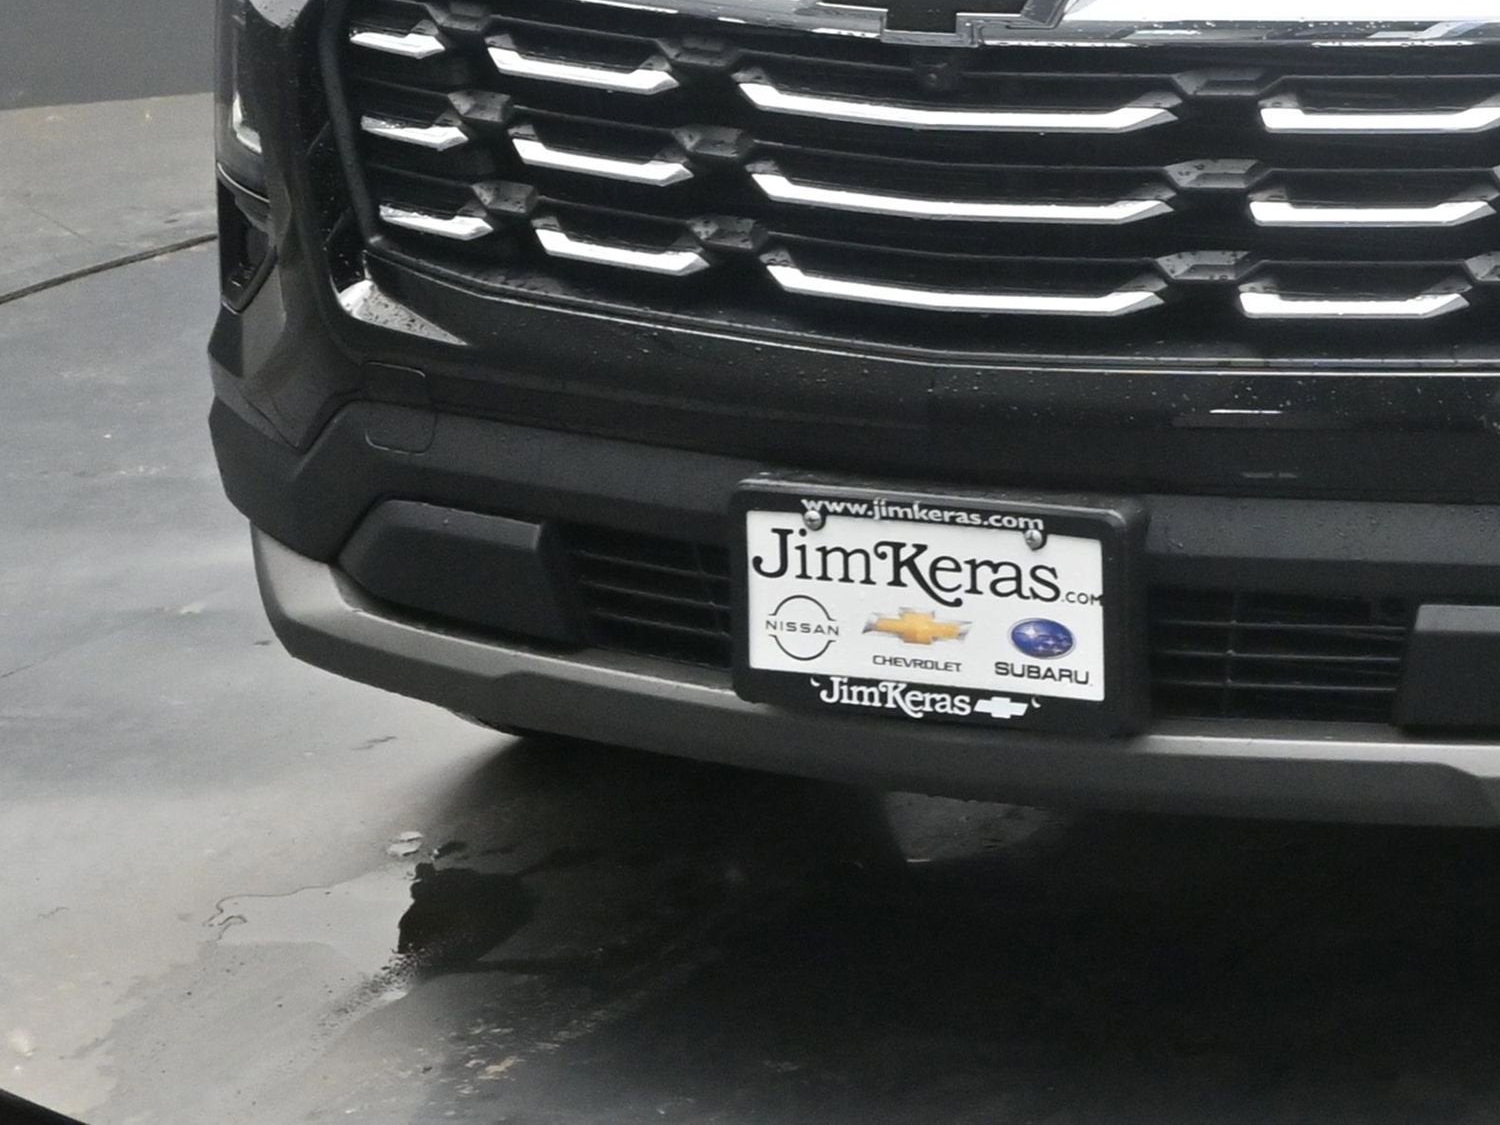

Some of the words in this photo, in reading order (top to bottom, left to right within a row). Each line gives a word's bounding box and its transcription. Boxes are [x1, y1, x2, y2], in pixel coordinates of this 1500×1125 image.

[801, 498, 1044, 531] www.jimkeras.com
[766, 619, 839, 636] NISSAN
[873, 655, 962, 672] CHEVROLET
[995, 661, 1089, 684] SUBARU
